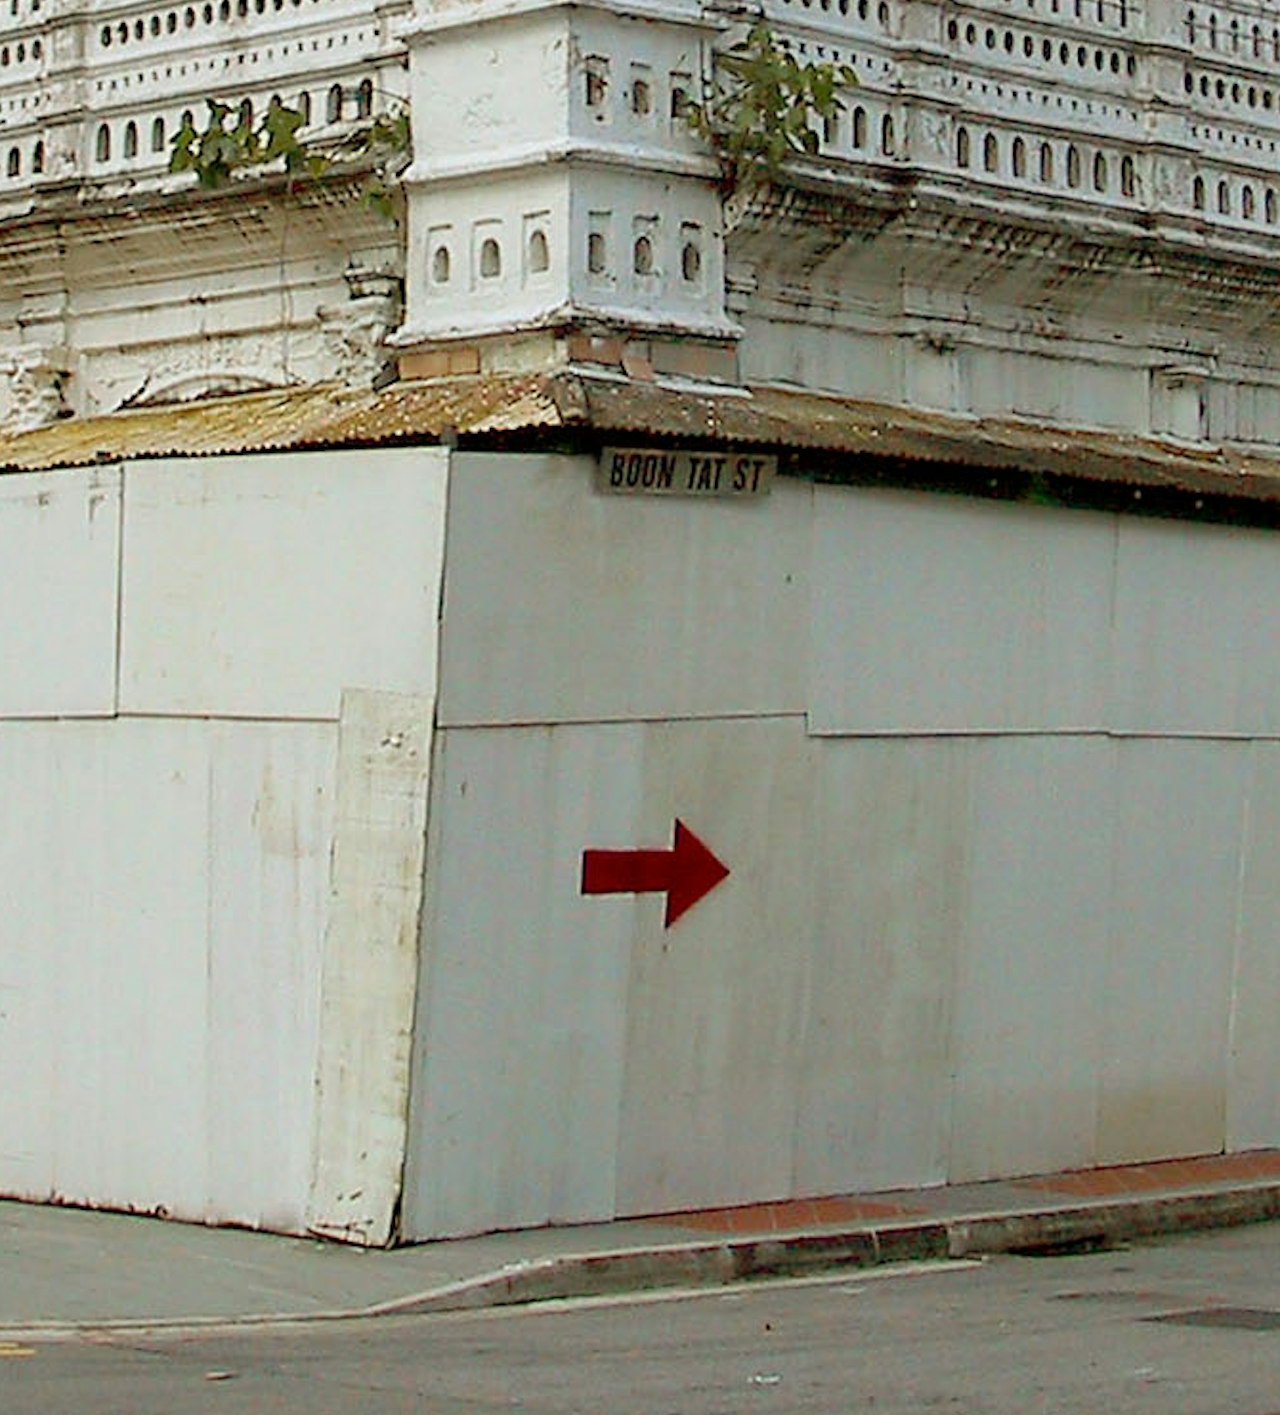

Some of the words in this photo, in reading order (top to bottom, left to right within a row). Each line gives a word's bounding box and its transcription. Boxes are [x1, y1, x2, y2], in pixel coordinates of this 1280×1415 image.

[609, 453, 676, 488] BOON
[686, 457, 727, 490] TAT
[733, 458, 767, 493] ST
